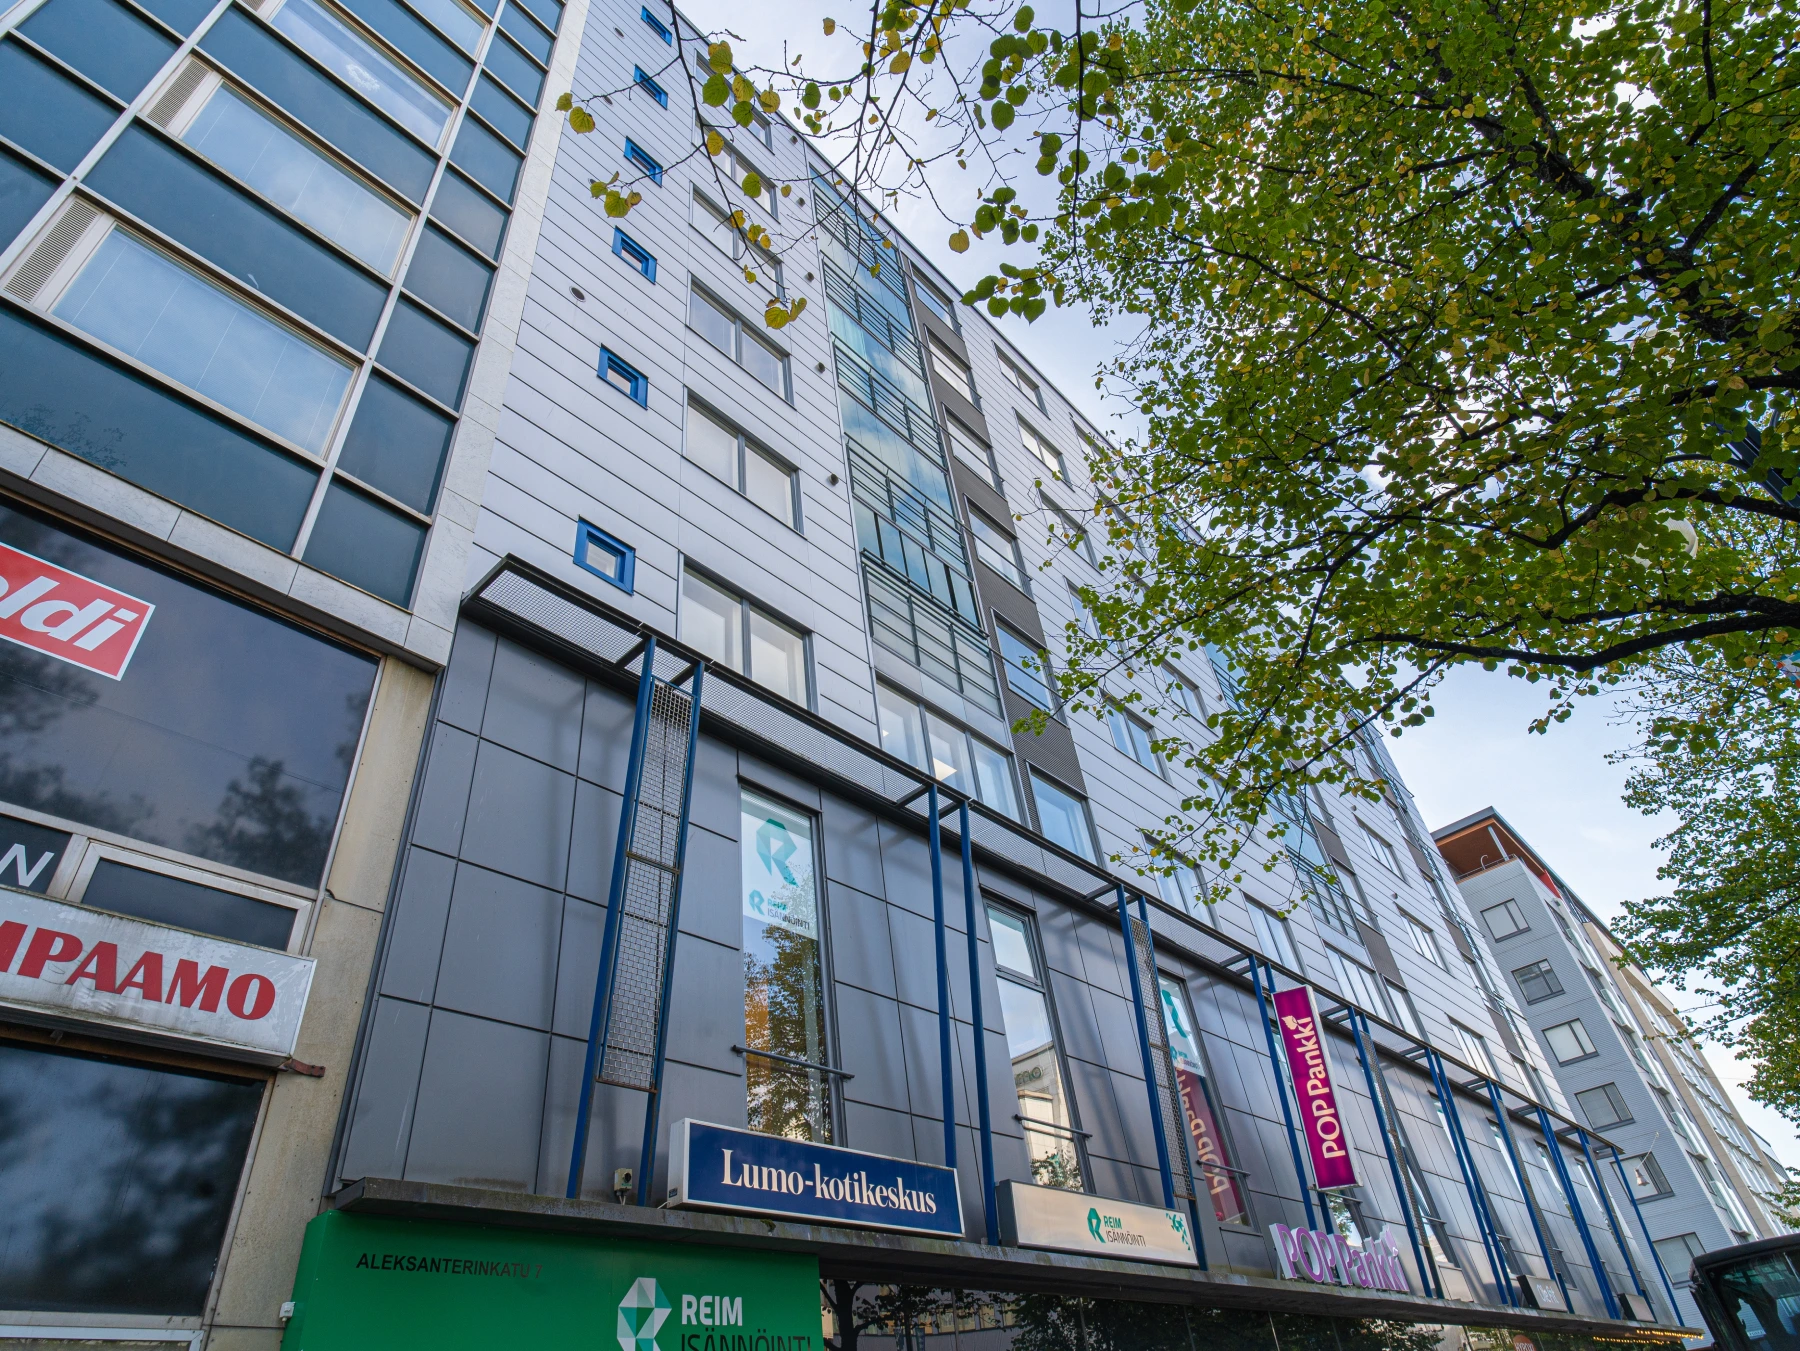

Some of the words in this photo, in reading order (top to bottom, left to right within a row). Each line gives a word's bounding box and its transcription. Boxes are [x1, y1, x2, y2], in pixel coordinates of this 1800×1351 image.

[0, 575, 139, 652] ldi
[1282, 1014, 1330, 1097] Pankki
[1313, 1099, 1347, 1159] POP
[721, 1148, 937, 1214] Lumo-kotikeskus
[1103, 1215, 1122, 1230] REIM
[1105, 1228, 1147, 1247] ISÄNNÖINTI
[356, 1252, 531, 1278] ALEKSANTERINKATU
[534, 1263, 543, 1279] 7
[1271, 1223, 1337, 1283] POP
[1330, 1224, 1410, 1292] Pankki
[681, 1294, 743, 1327] REIM
